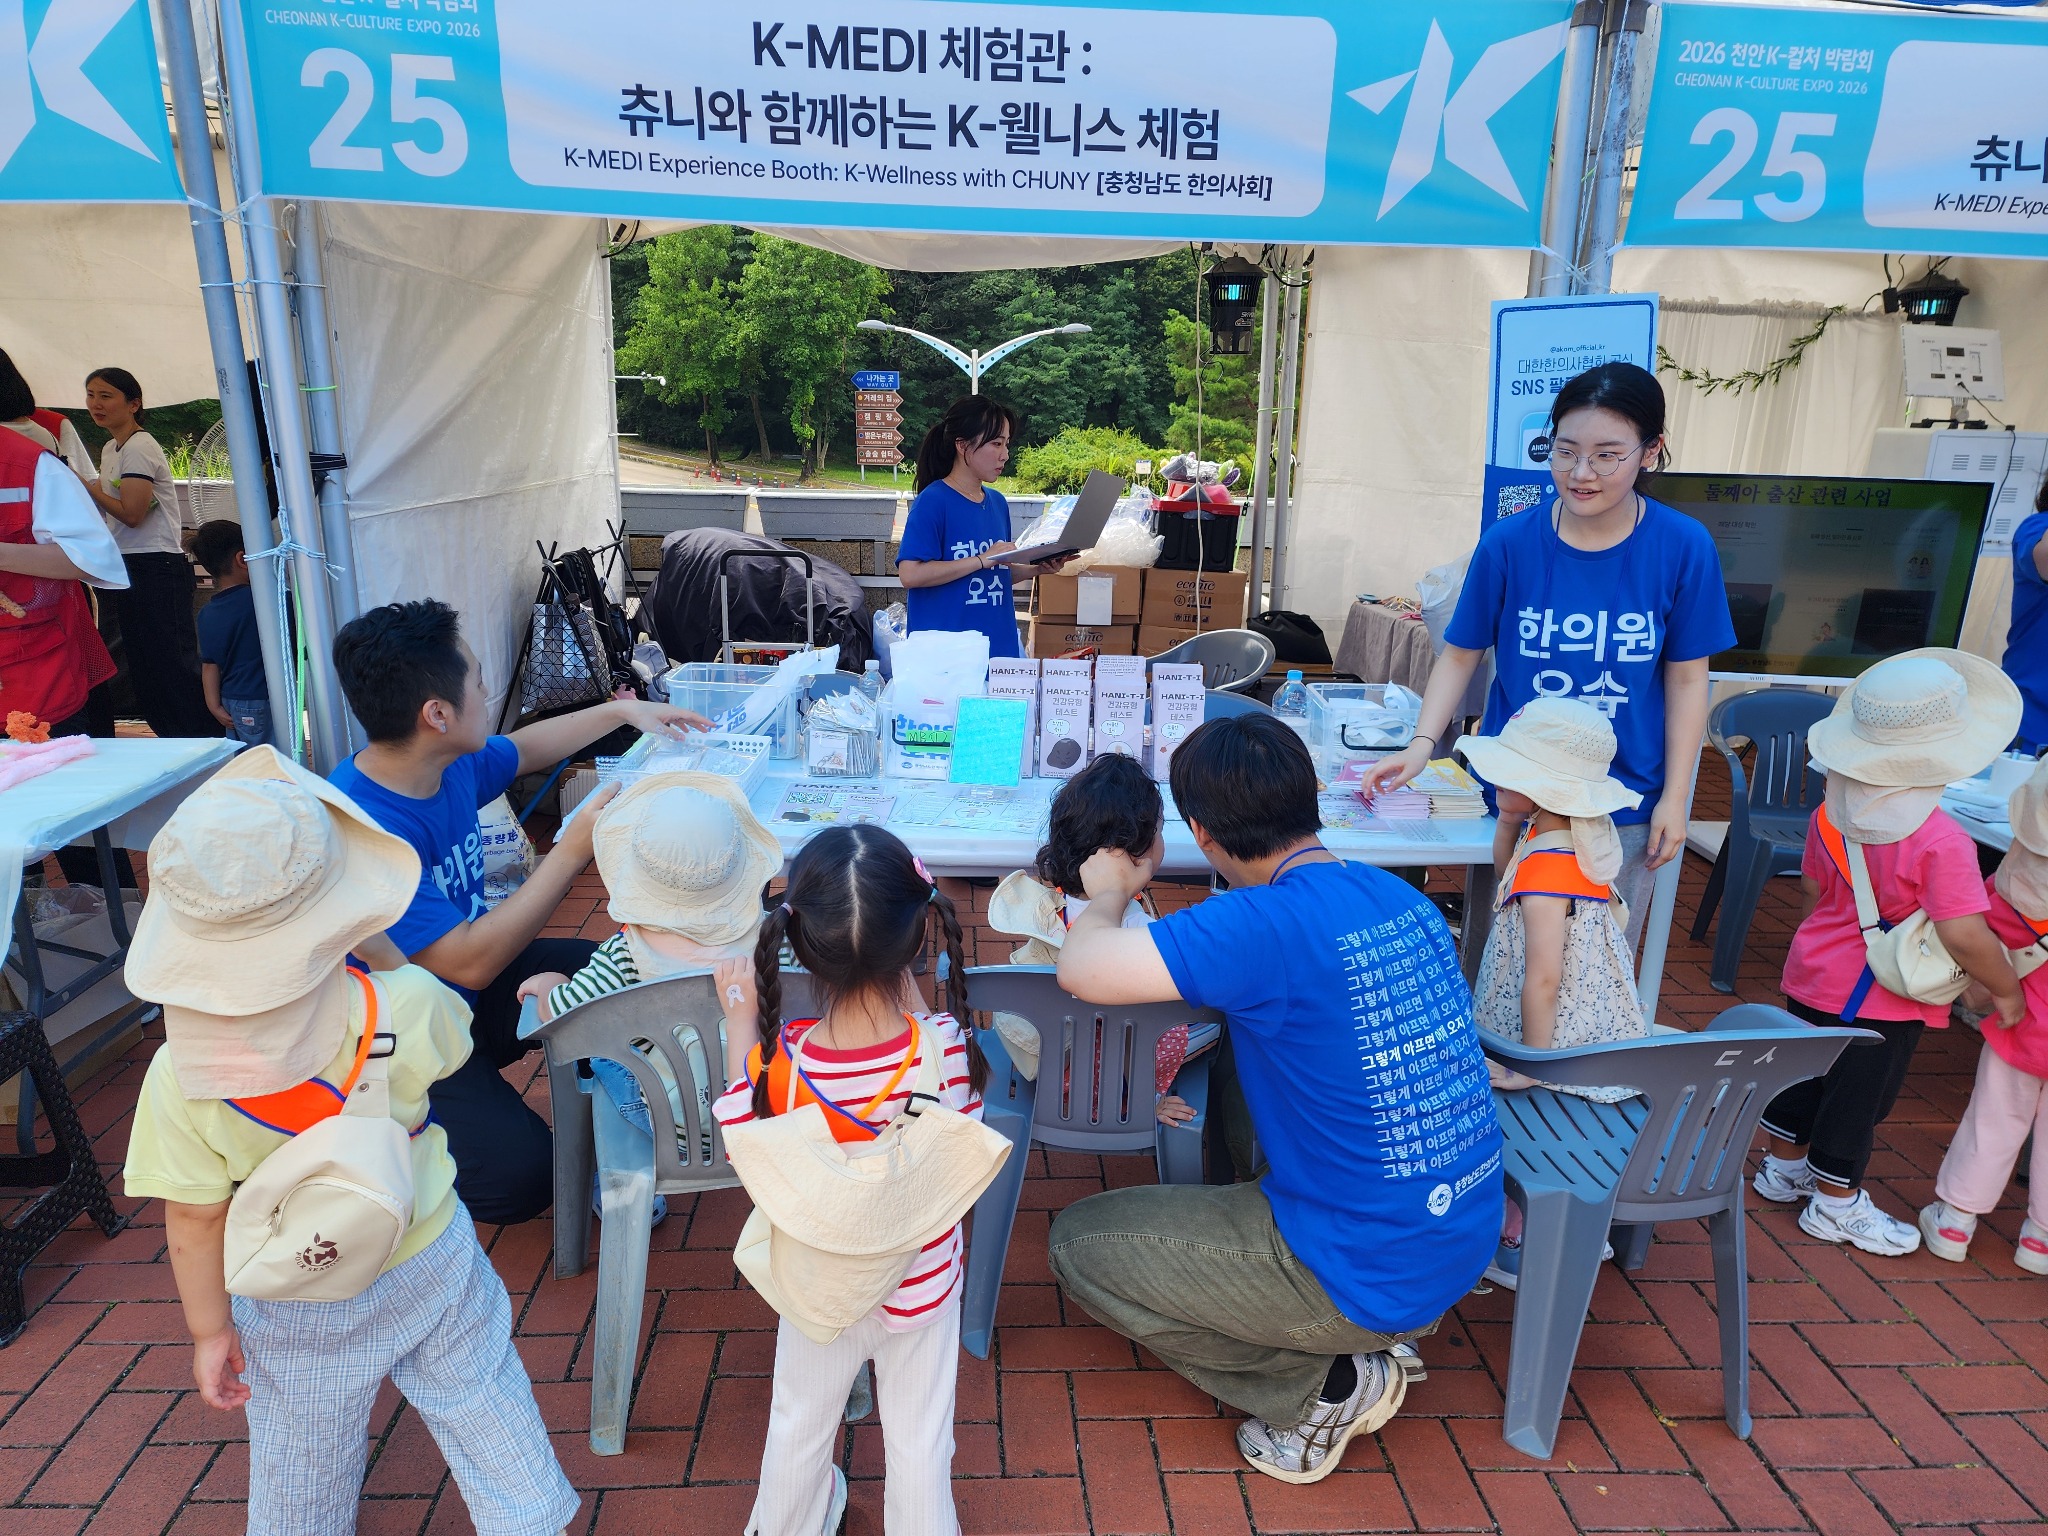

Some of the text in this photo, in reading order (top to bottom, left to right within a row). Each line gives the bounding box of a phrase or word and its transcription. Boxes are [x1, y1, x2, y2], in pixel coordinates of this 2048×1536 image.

[265, 9, 481, 38] CHEONAN K-CULTURE EXPO 2026
[752, 21, 927, 74] K-MEDI
[938, 26, 1071, 84] 체험관
[1678, 40, 1875, 74] 2026 천안 K-컬처 박람회
[1675, 72, 1868, 95] CHEONAN K-CULTURE EXPO 2026
[300, 46, 469, 177] 25
[618, 83, 1220, 161] 츄니와 함께하는 K-웰니스 체험
[564, 147, 1273, 201] K-MEDI Experience Booth: K-Wellness with CHUNY [충청남도 한의사회]
[1674, 107, 1838, 223] 25
[1933, 192, 2007, 214] K-MEDI
[866, 374, 895, 383] 나가는 곳
[1511, 378, 1545, 396] SNS
[1704, 482, 1892, 508] 둘째아 출산 관련 사업
[965, 575, 1004, 607] 오슈
[1518, 606, 1656, 662] 한의원
[1052, 697, 1083, 706] 건강유형
[1055, 708, 1078, 717] 테스트
[1107, 700, 1138, 710] 건강유형
[1110, 711, 1133, 719] 테스트
[1167, 702, 1198, 711] 건강유형
[1170, 713, 1193, 721] 테스트
[1336, 928, 1372, 951] 그렇게
[1396, 909, 1418, 930] 오지
[1343, 947, 1380, 971] 그렇게
[1347, 967, 1384, 991] 그렇게
[1418, 943, 1436, 962] 오지
[1350, 987, 1389, 1011] 그렇게
[1390, 975, 1419, 997] 아프면
[1425, 961, 1444, 980] 오지
[1354, 1007, 1394, 1031] 그렇게
[1394, 994, 1424, 1017] 아프면
[1434, 979, 1452, 998] 오지
[1358, 1026, 1397, 1050] 그렇게
[1399, 1014, 1431, 1037] 아프면
[1440, 996, 1460, 1017] 오지
[1361, 1046, 1402, 1070] 그렇게
[1403, 1032, 1437, 1056] 아프면
[1447, 1014, 1466, 1035] 오지
[1365, 1065, 1406, 1090] 그렇게
[1408, 1051, 1438, 1076] 아프면
[1454, 1033, 1471, 1053] 오지
[1369, 1085, 1411, 1109] 그렇게
[1413, 1070, 1444, 1094] 아프면
[1460, 1051, 1478, 1072] 오지
[1373, 1103, 1416, 1125] 그렇게
[1419, 1089, 1452, 1114] 아프면
[1463, 1069, 1480, 1089] 오지
[1377, 1121, 1420, 1143] 그렇게
[1421, 1107, 1453, 1131] 아프면
[1470, 1087, 1487, 1107] 오지
[1380, 1139, 1423, 1161] 그렇게
[1426, 1125, 1457, 1150] 아프면
[1471, 1104, 1488, 1125] 오지
[1383, 1158, 1428, 1179] 그렇게
[1430, 1144, 1460, 1169] 아프면
[1475, 1121, 1492, 1142] 오지
